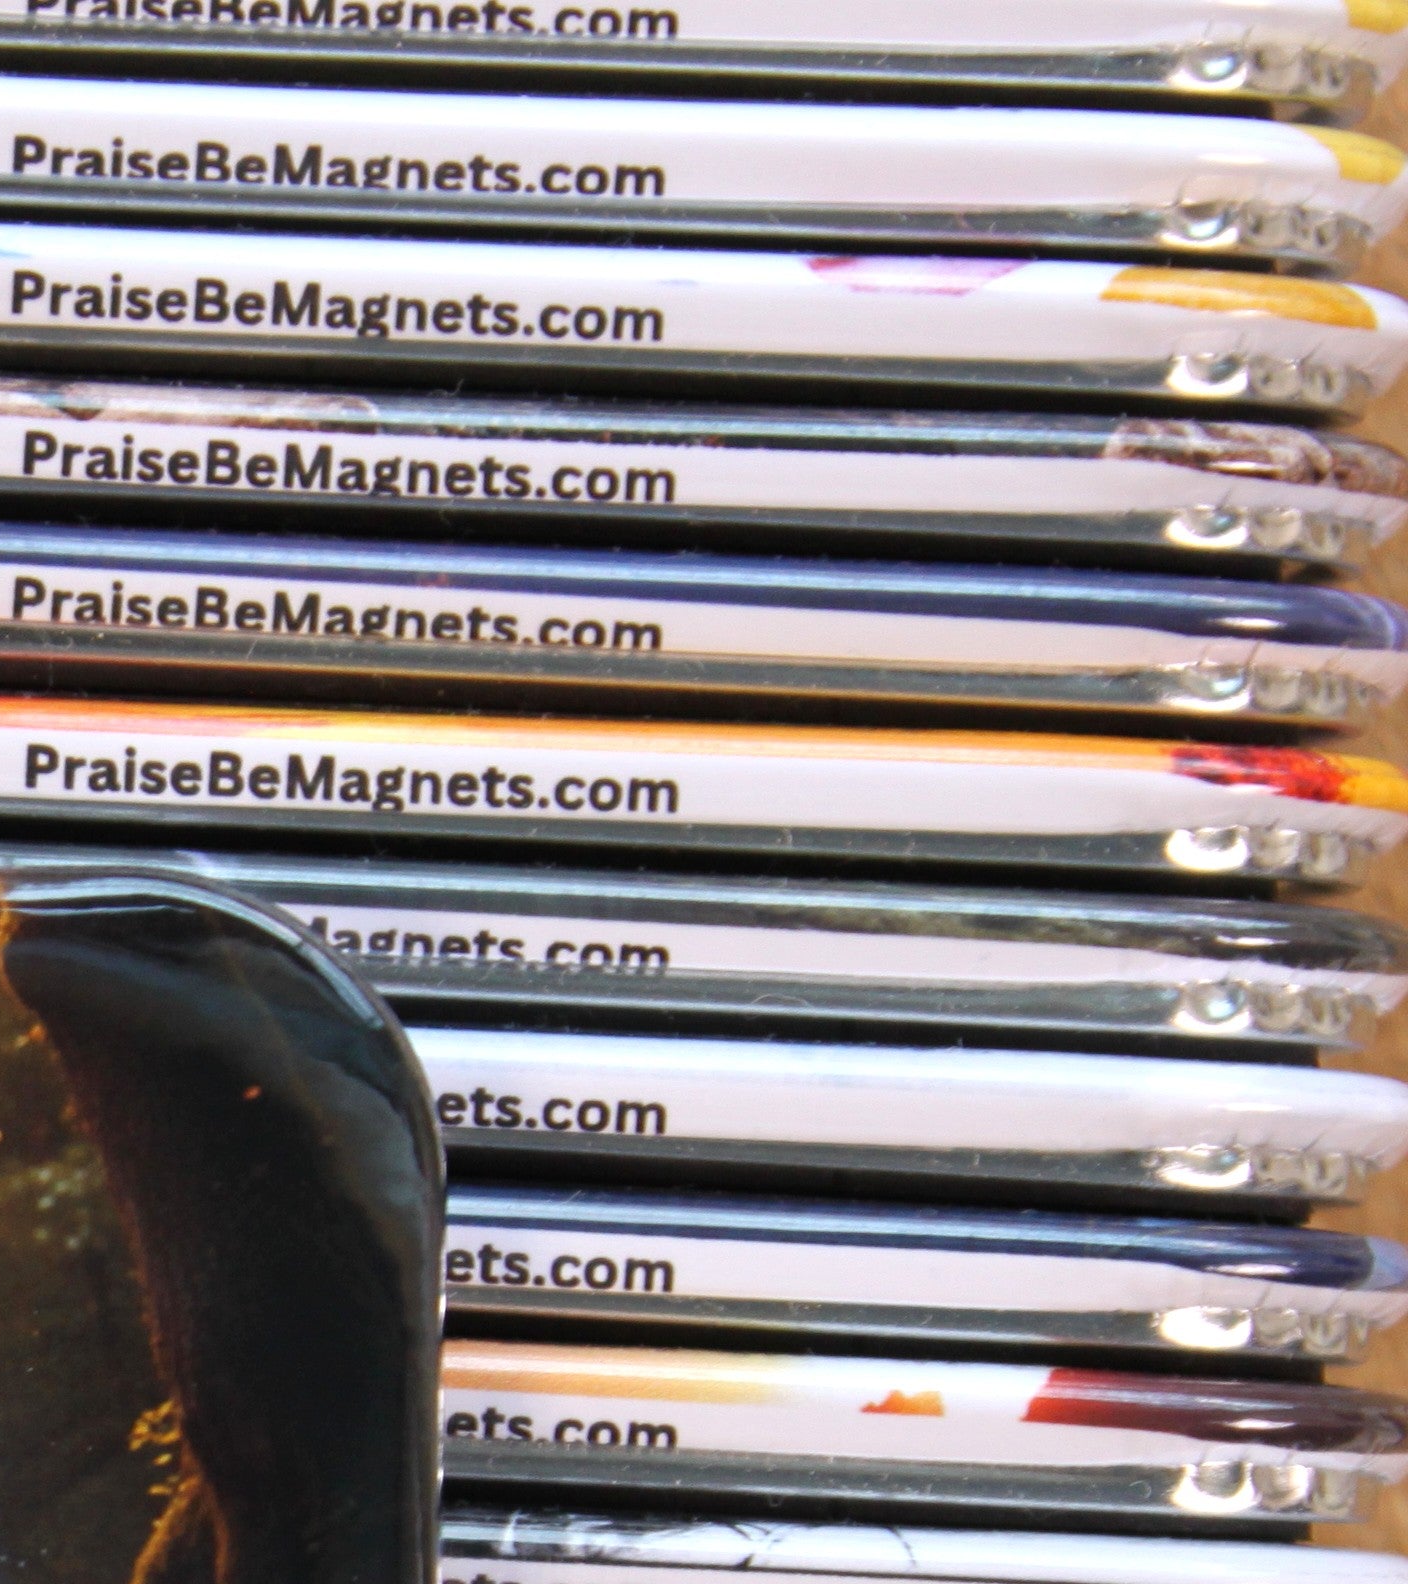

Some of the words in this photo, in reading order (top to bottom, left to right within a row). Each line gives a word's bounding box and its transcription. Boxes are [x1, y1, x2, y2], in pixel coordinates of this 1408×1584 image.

[12, 135, 666, 197] PraiseBeMagnets.com
[11, 270, 664, 341] PraiseBeMagnets.com
[22, 430, 675, 504] PraiseBeMagnets.com
[12, 577, 662, 651] PraiseBeMagnets.com
[24, 743, 678, 813] PraiseBeMagnets.com
